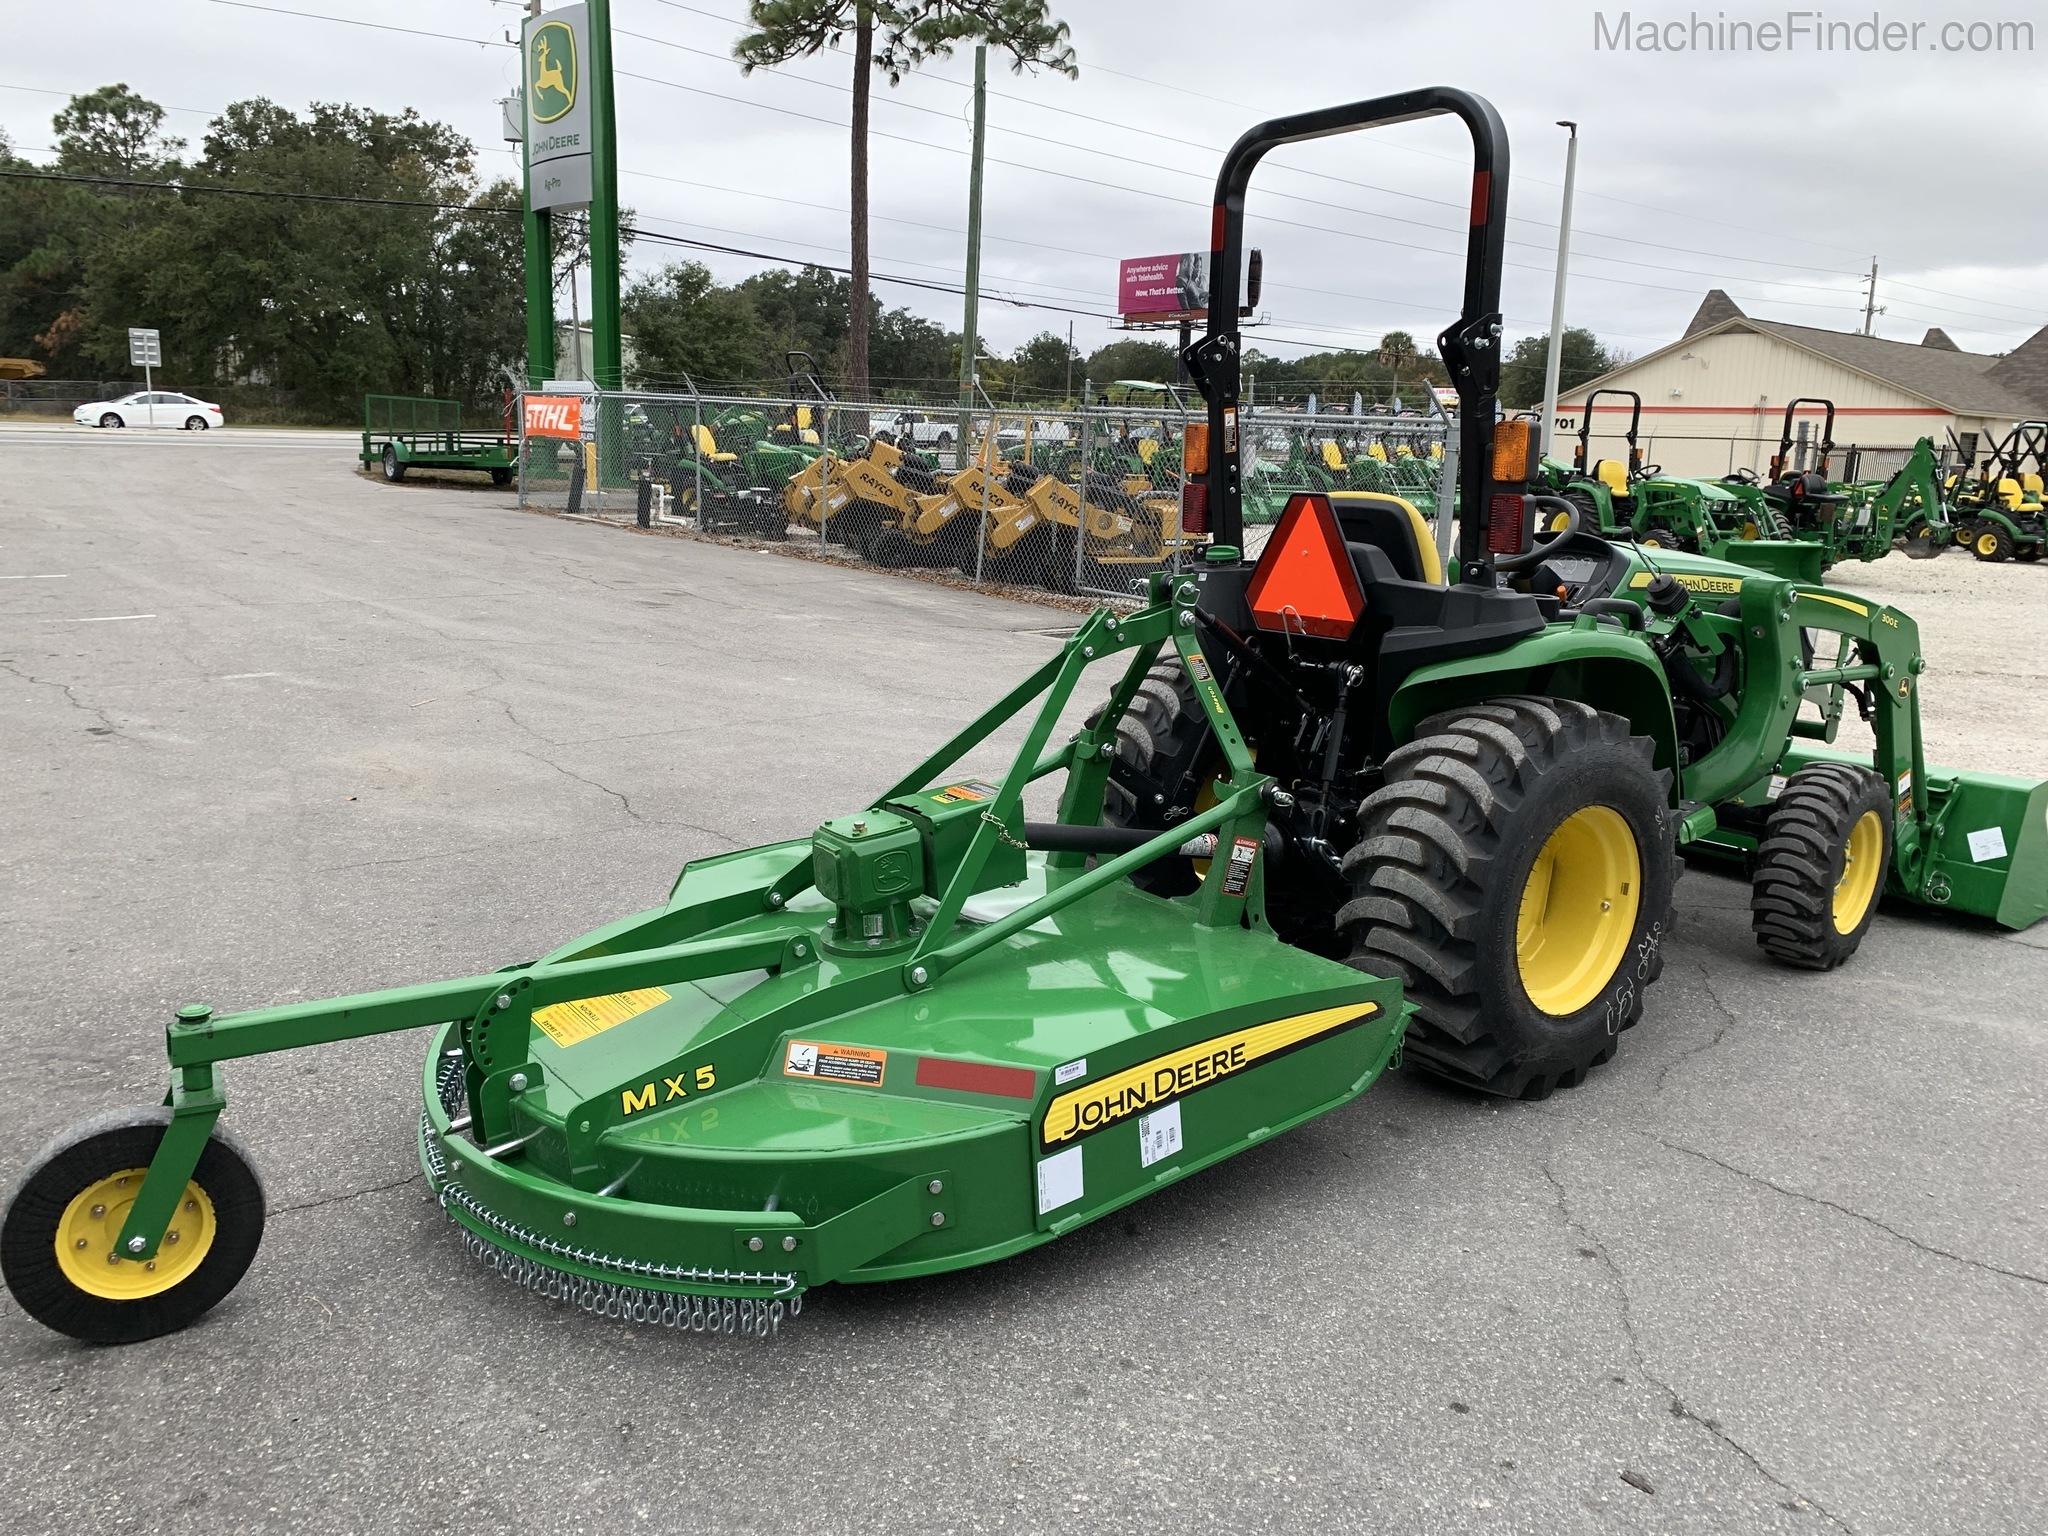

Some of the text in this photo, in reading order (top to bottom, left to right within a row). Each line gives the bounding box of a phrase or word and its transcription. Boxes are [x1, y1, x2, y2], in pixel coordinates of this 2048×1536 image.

[532, 133, 580, 156] JOHN DEERE
[544, 177, 562, 191] Ag-Pro
[1126, 263, 1169, 275] Anywhere advice
[1126, 272, 1165, 283] with Telehealth.
[1149, 287, 1165, 296] That's
[526, 403, 574, 431] STIHL
[859, 472, 893, 498] RAYCO
[969, 481, 1005, 507] RACO
[1701, 578, 1735, 592] DEERE
[1881, 613, 1899, 628] 300E
[841, 1049, 871, 1058] WARNING
[1064, 1042, 1246, 1136] JOHN DEERE
